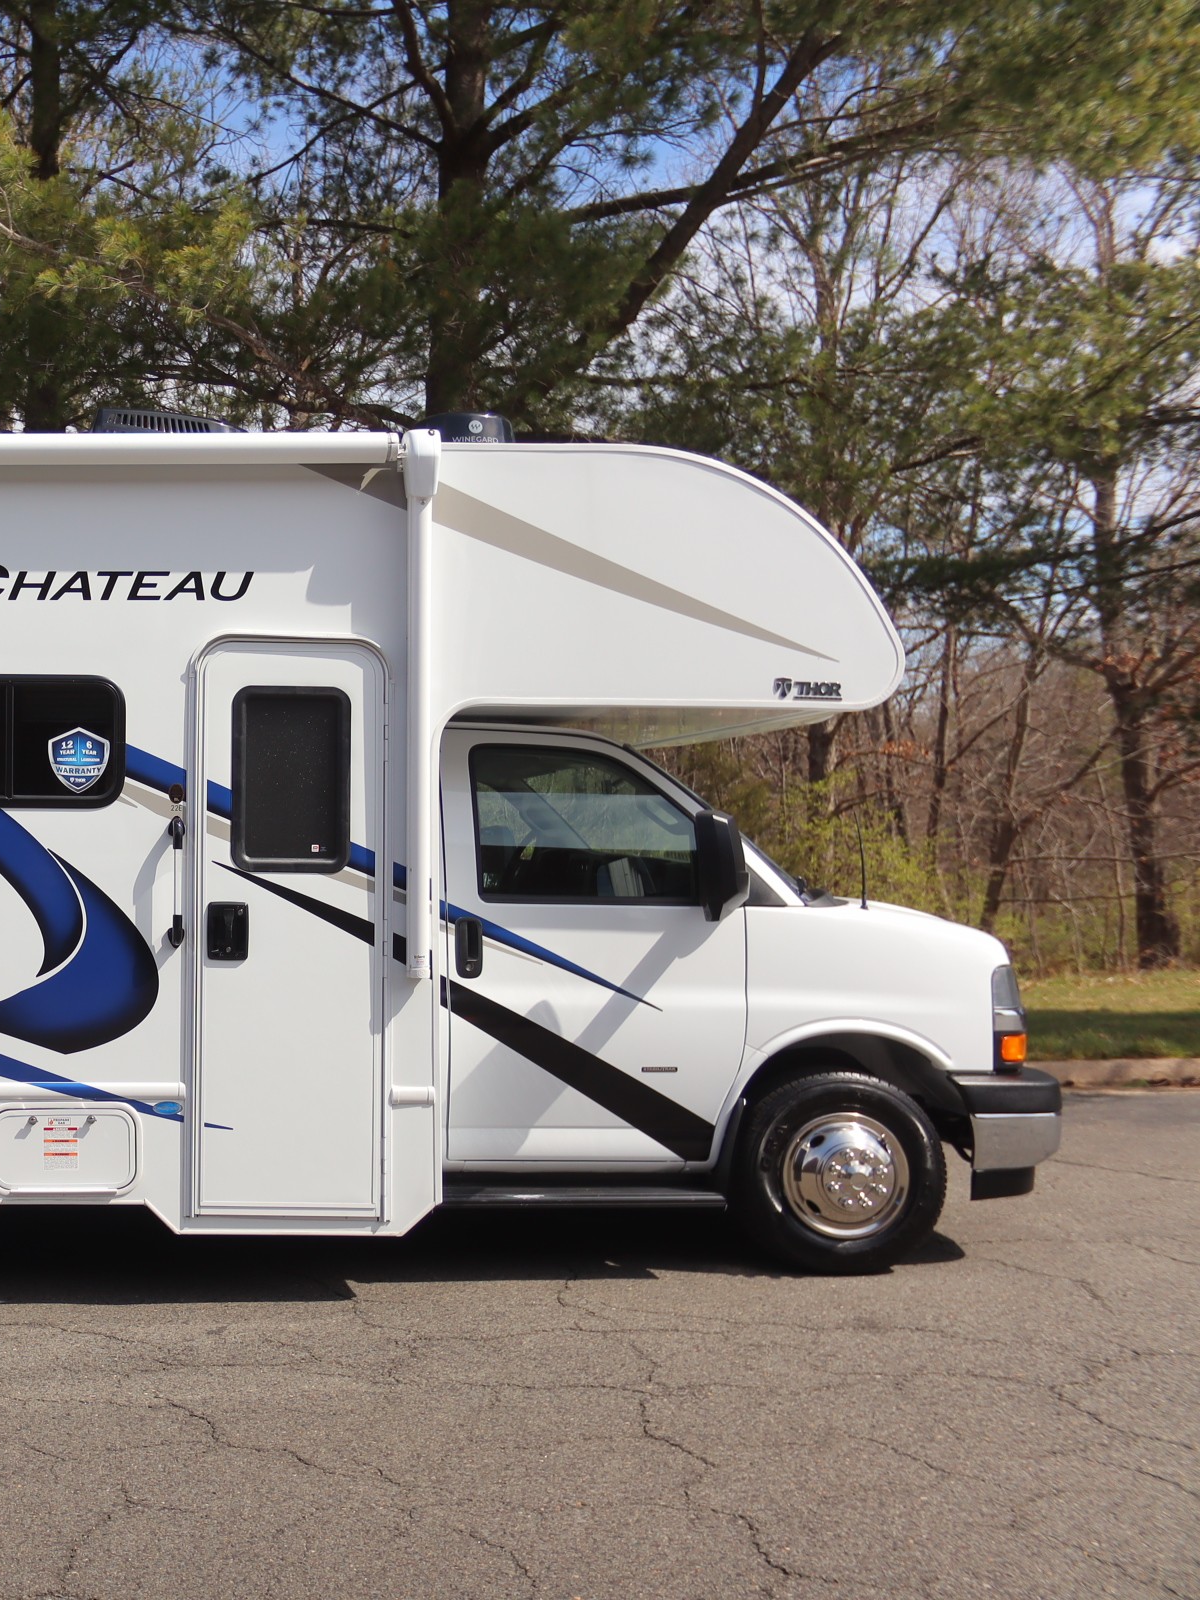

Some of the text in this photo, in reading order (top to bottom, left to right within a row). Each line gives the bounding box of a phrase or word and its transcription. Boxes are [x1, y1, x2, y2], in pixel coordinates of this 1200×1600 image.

[793, 681, 841, 696] THOR
[61, 740, 73, 749] 12
[86, 741, 92, 749] 6
[55, 766, 102, 774] WARRANTY
